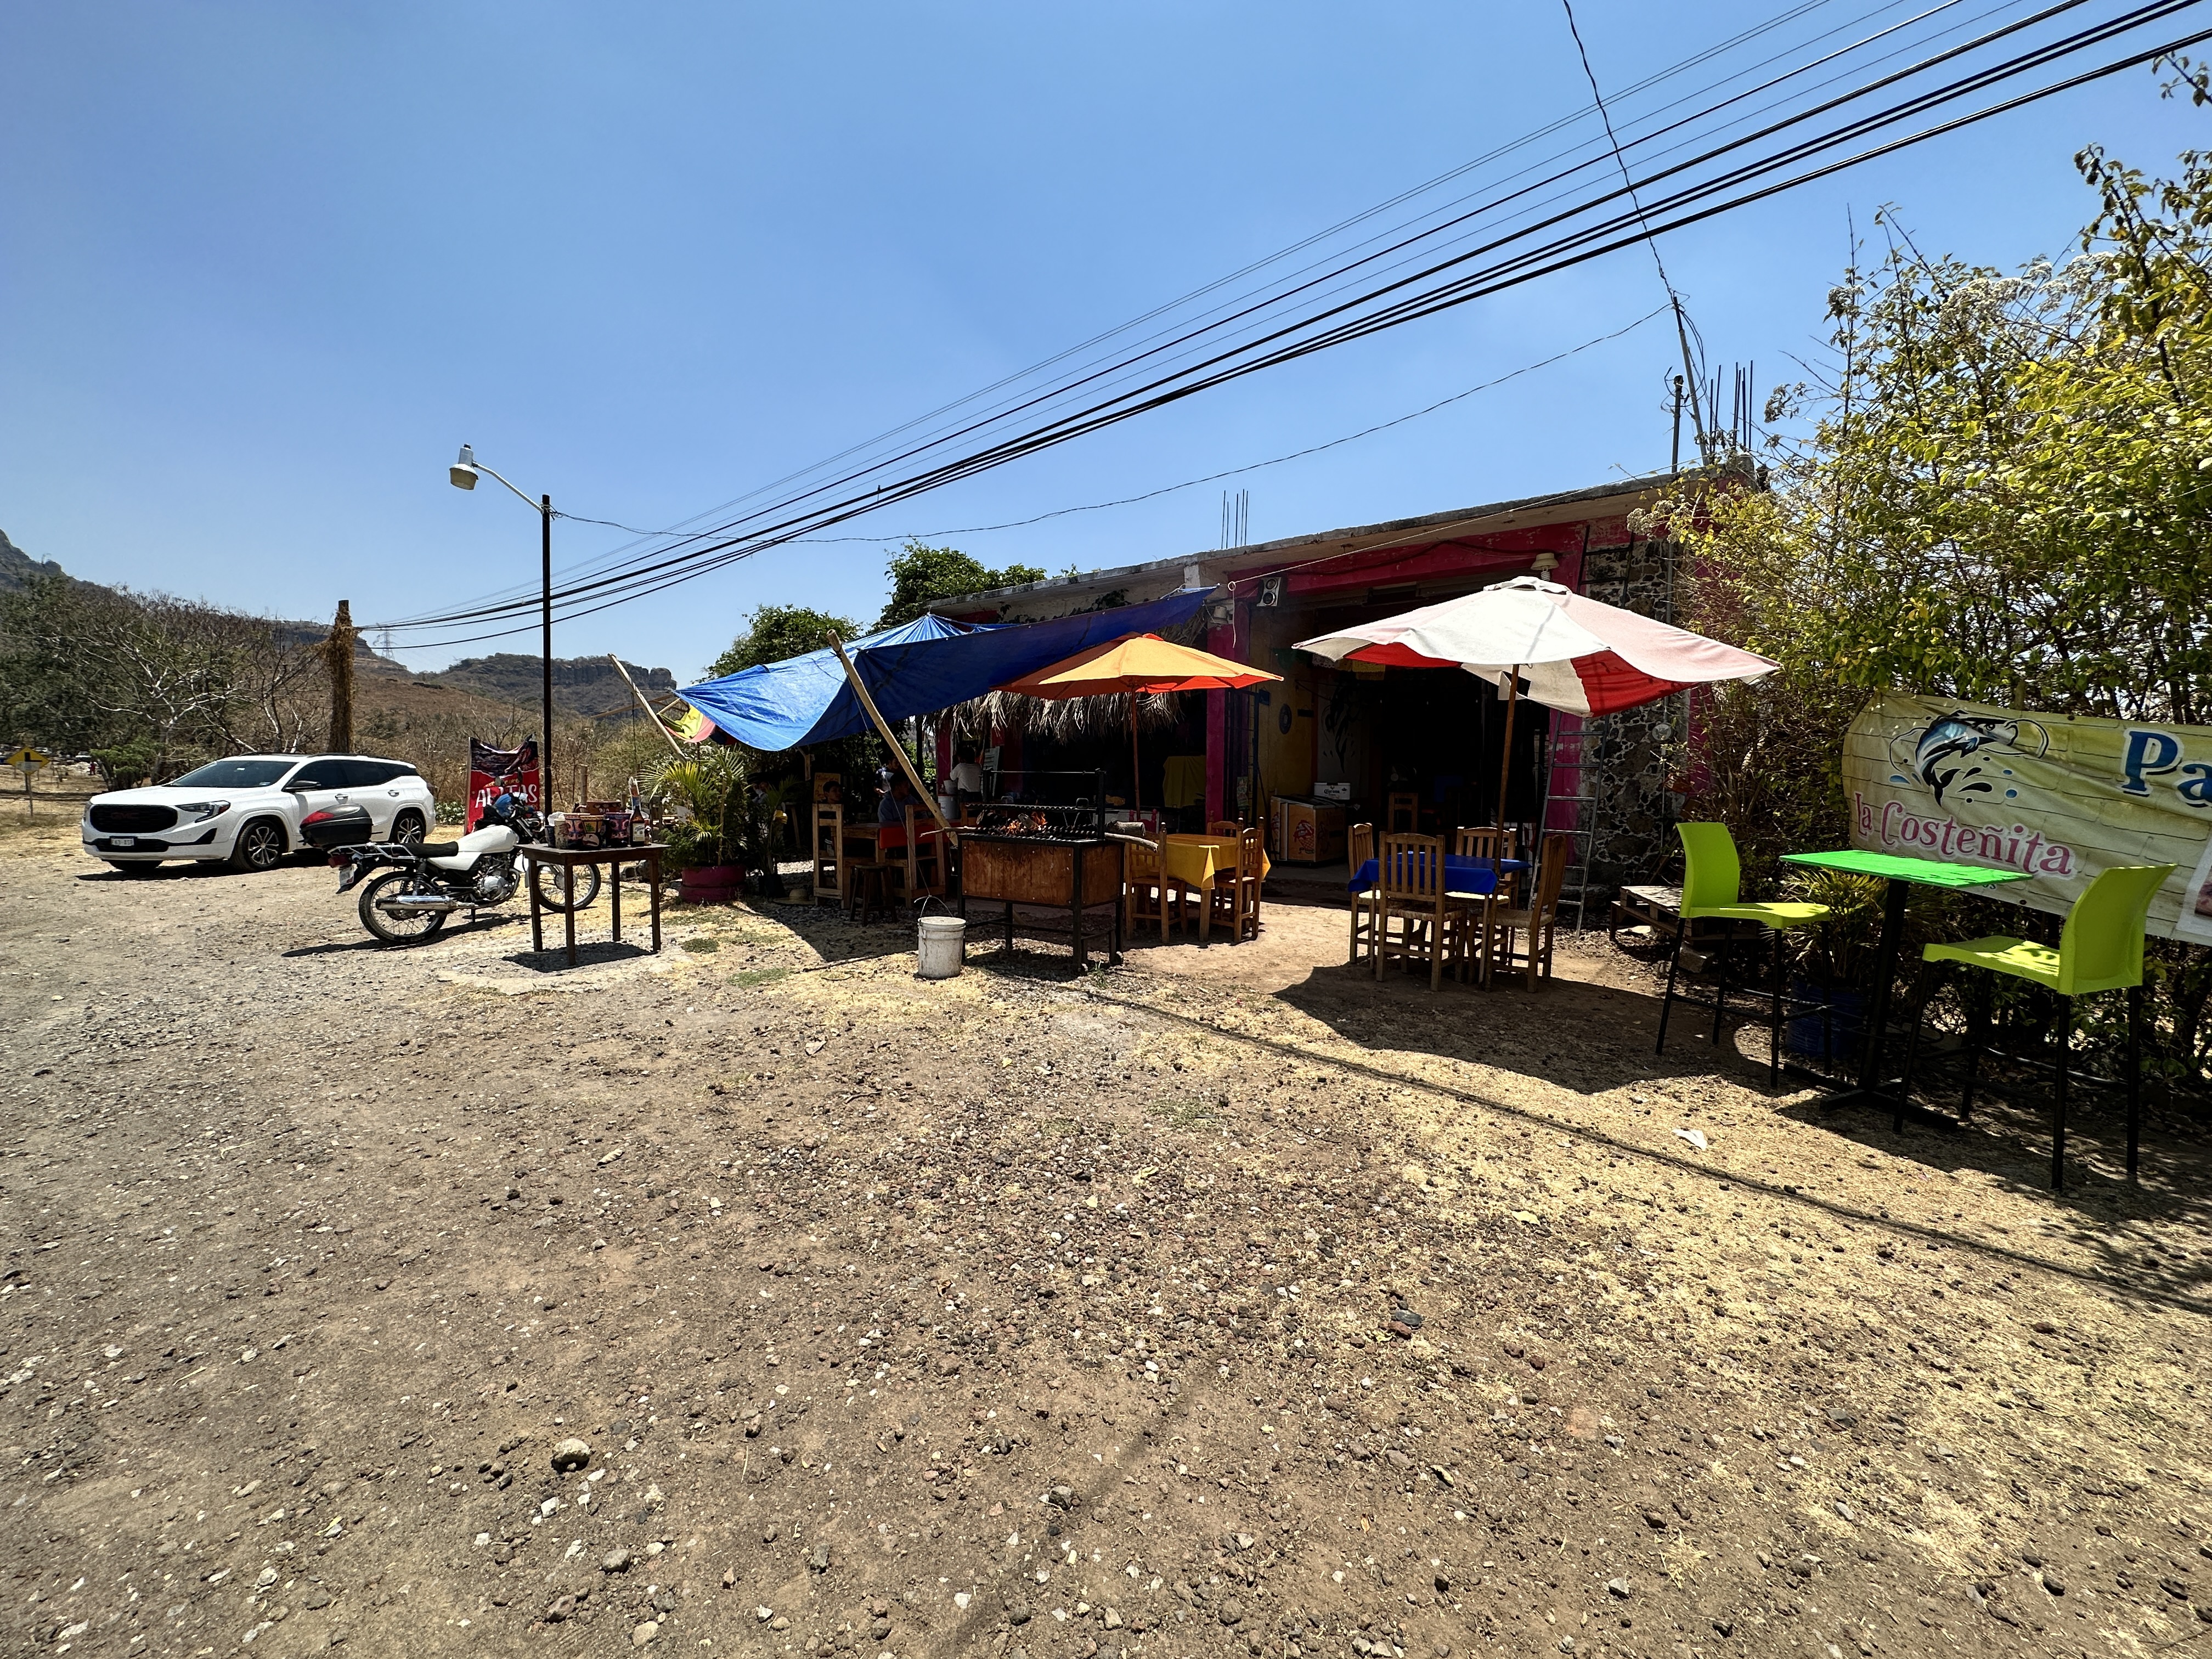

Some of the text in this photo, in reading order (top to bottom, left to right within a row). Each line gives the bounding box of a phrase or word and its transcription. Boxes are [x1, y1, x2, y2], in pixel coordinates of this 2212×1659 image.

[2121, 730, 2212, 808] Pa
[1855, 793, 2072, 874] La Costeñita
